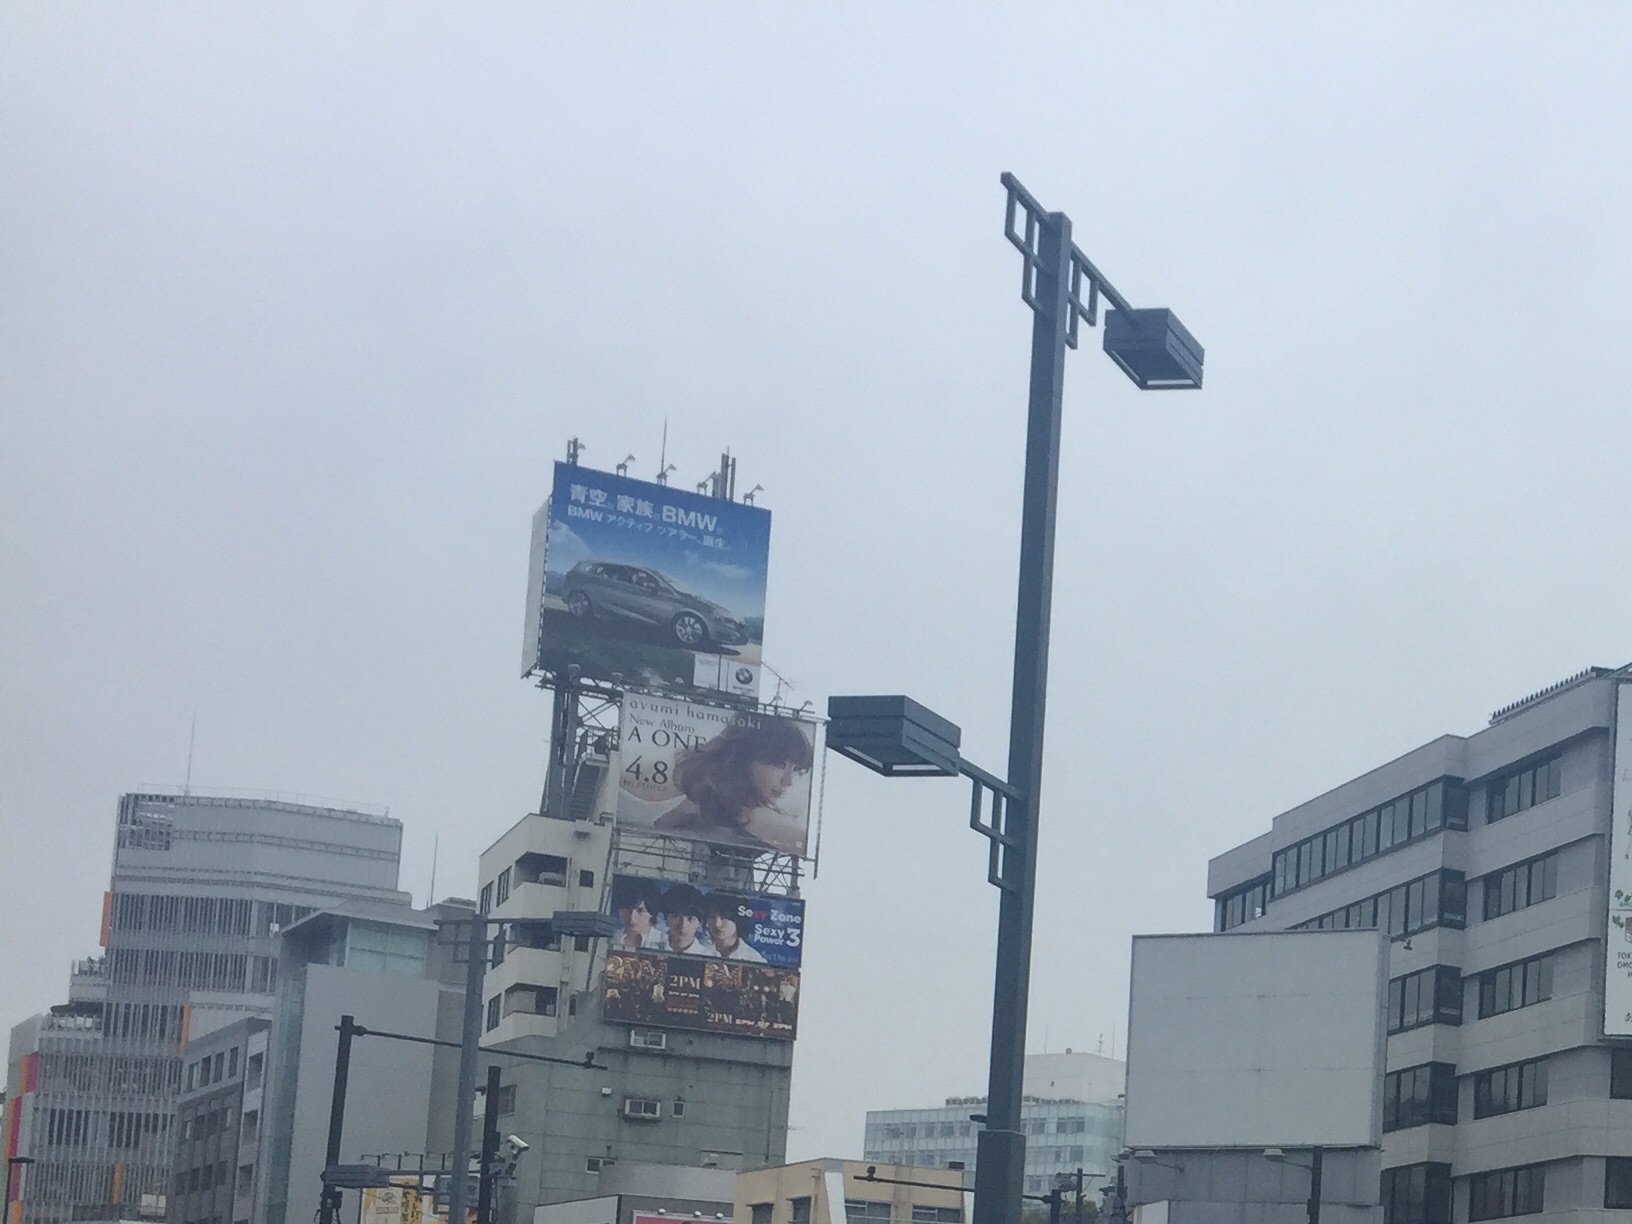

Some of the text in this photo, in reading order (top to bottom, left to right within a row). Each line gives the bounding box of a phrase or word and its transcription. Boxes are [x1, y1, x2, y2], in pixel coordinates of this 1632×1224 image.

[568, 504, 602, 522] BMW
[630, 713, 695, 733] New Album
[628, 726, 641, 743] A
[625, 755, 668, 784] 4.8
[738, 905, 801, 924] Sexy Zone
[753, 928, 801, 947] Power 3
[754, 923, 785, 939] Sexy
[669, 975, 700, 989] 2PM
[706, 1012, 733, 1024] 2PM
